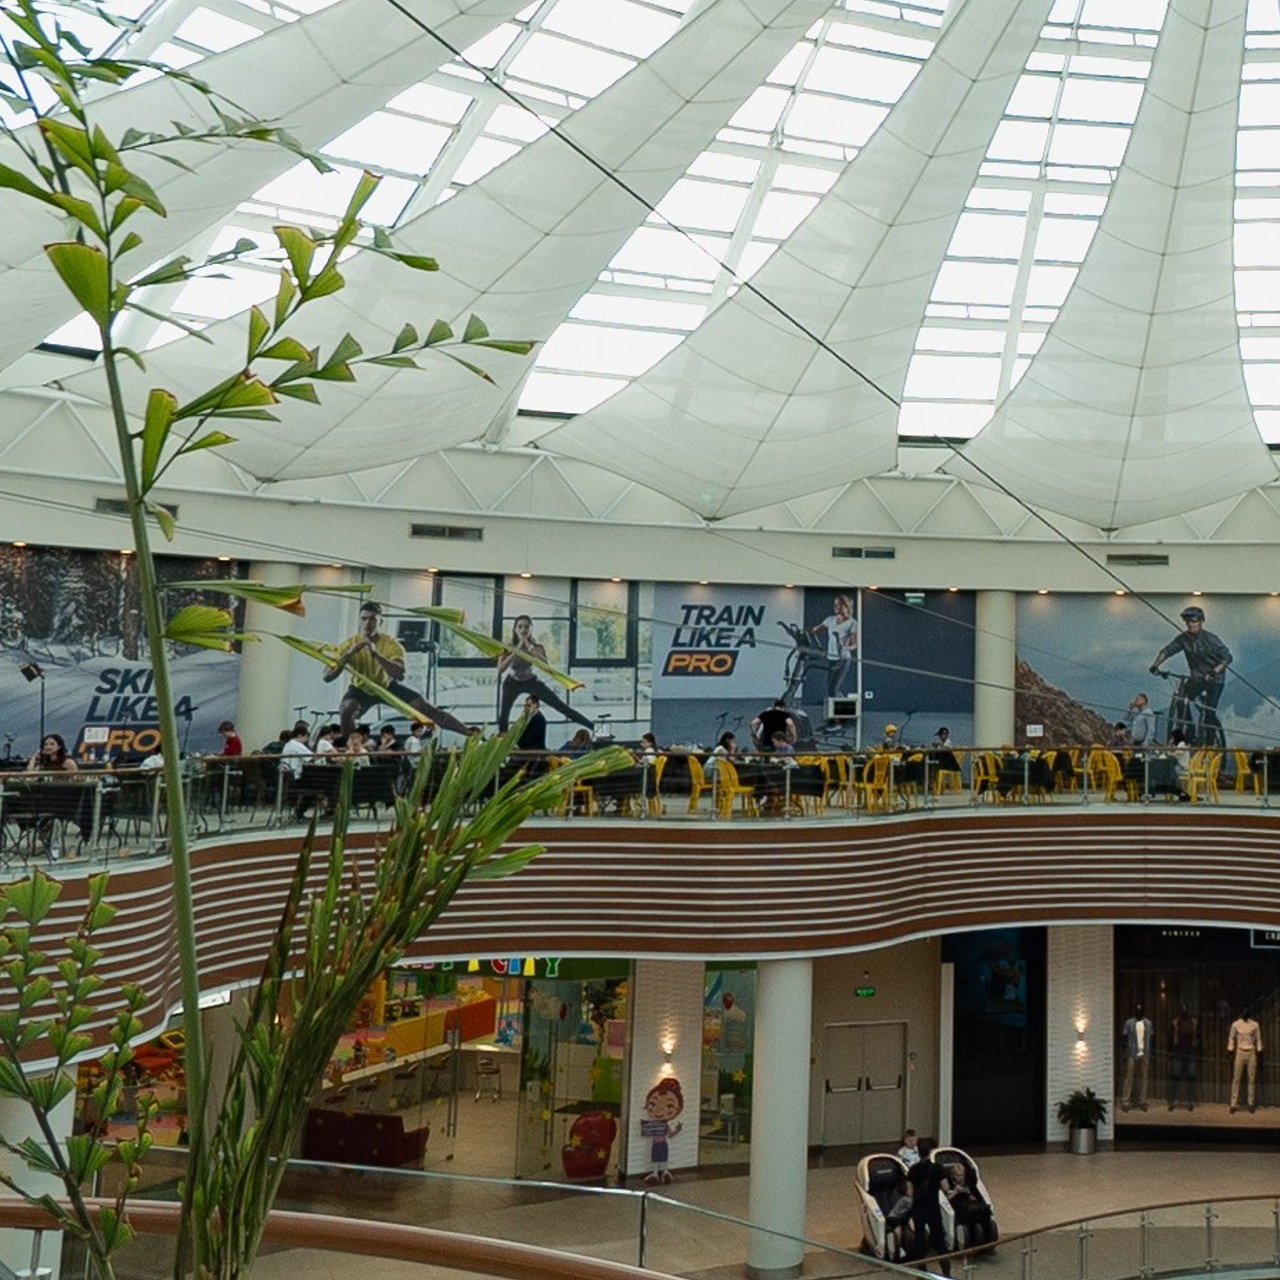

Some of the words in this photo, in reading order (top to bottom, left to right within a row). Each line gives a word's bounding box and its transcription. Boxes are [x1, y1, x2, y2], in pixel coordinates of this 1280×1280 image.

[681, 605, 766, 626] TRAIN
[671, 627, 735, 648] LIKE
[734, 627, 756, 648] A
[667, 653, 732, 673] PRO
[95, 668, 155, 694] SKI
[84, 695, 160, 722] LIKE
[78, 728, 161, 753] RO
